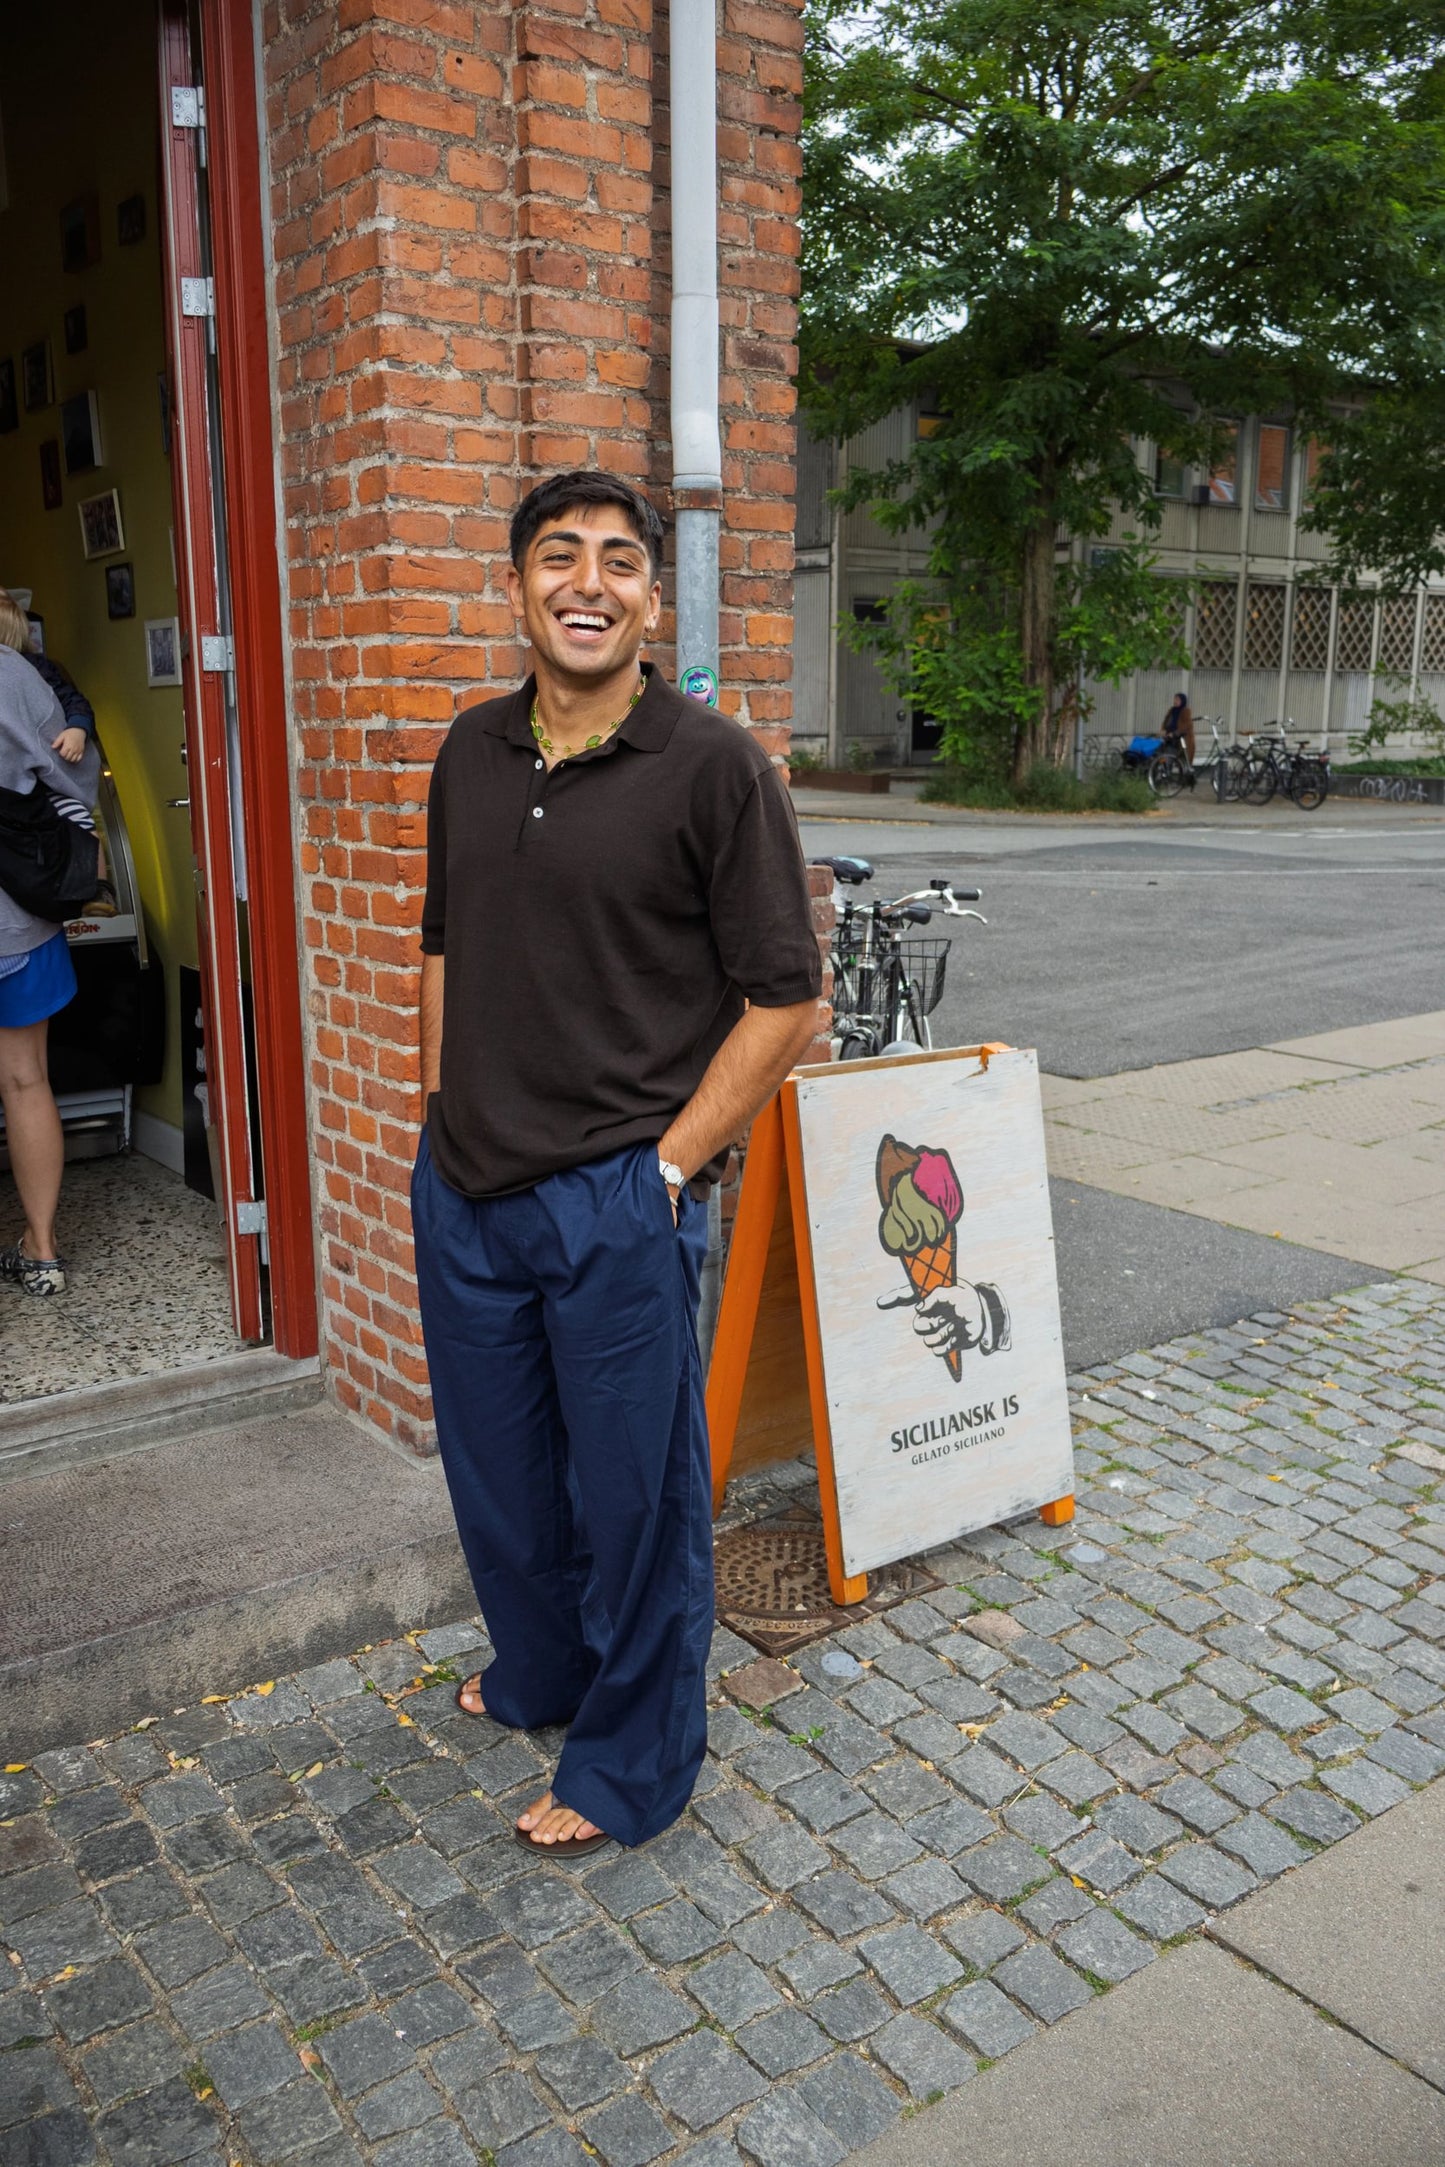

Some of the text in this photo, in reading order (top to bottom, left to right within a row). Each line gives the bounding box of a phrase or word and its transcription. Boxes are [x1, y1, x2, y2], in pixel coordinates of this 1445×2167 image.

[890, 1394, 1020, 1453] SICILIANSK IS
[911, 1426, 1006, 1465] GELATO SICILIANO
